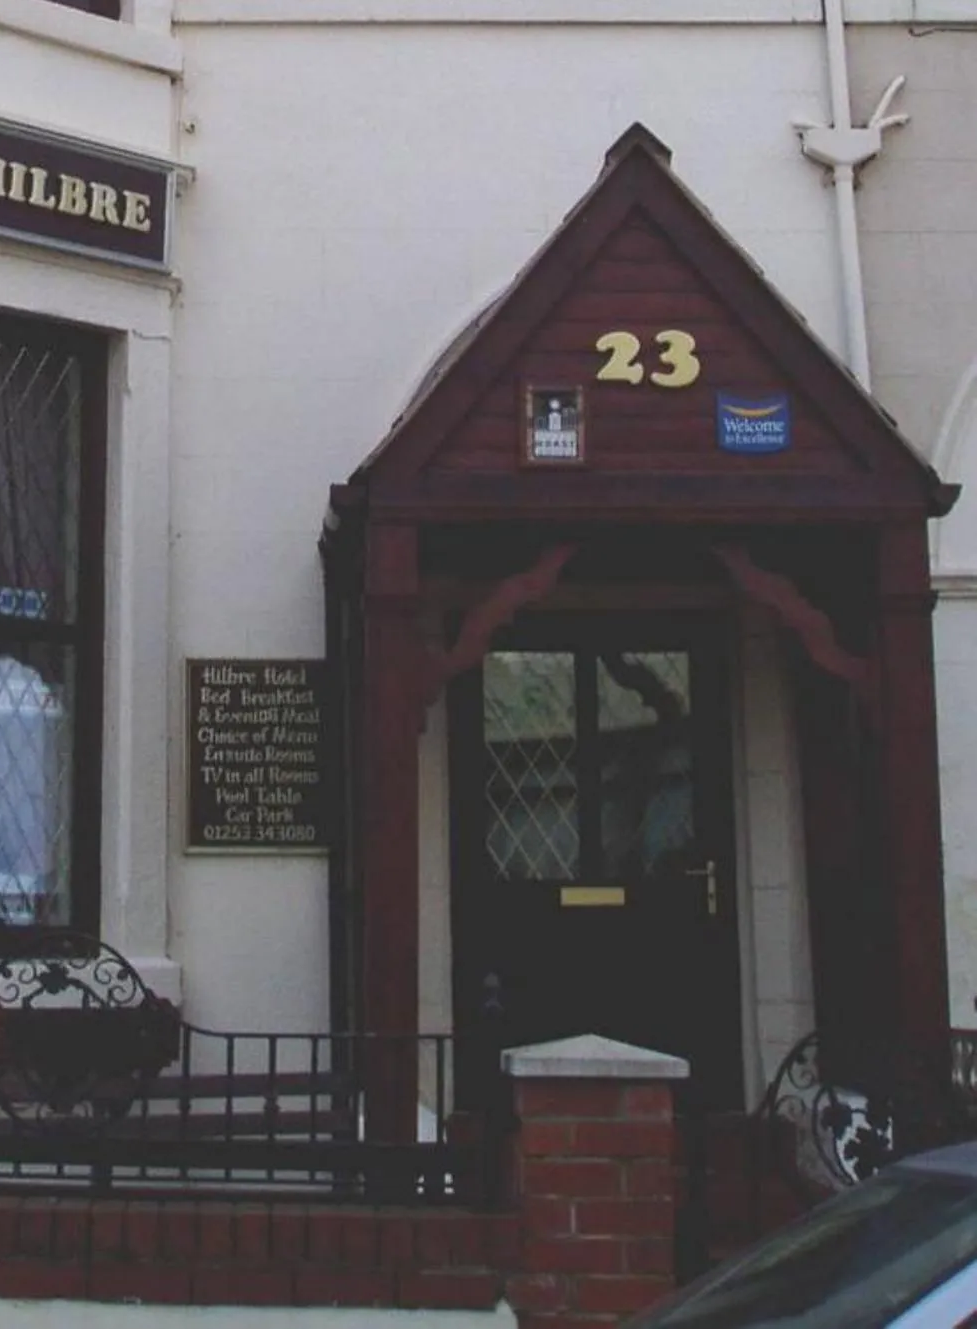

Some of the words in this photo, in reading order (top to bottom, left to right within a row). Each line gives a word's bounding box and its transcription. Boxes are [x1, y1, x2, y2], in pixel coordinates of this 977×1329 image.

[595, 329, 701, 388] 23
[723, 417, 785, 433] Welcome
[200, 686, 231, 705] Bed
[241, 687, 314, 706] Breakfast
[200, 766, 224, 784] TV
